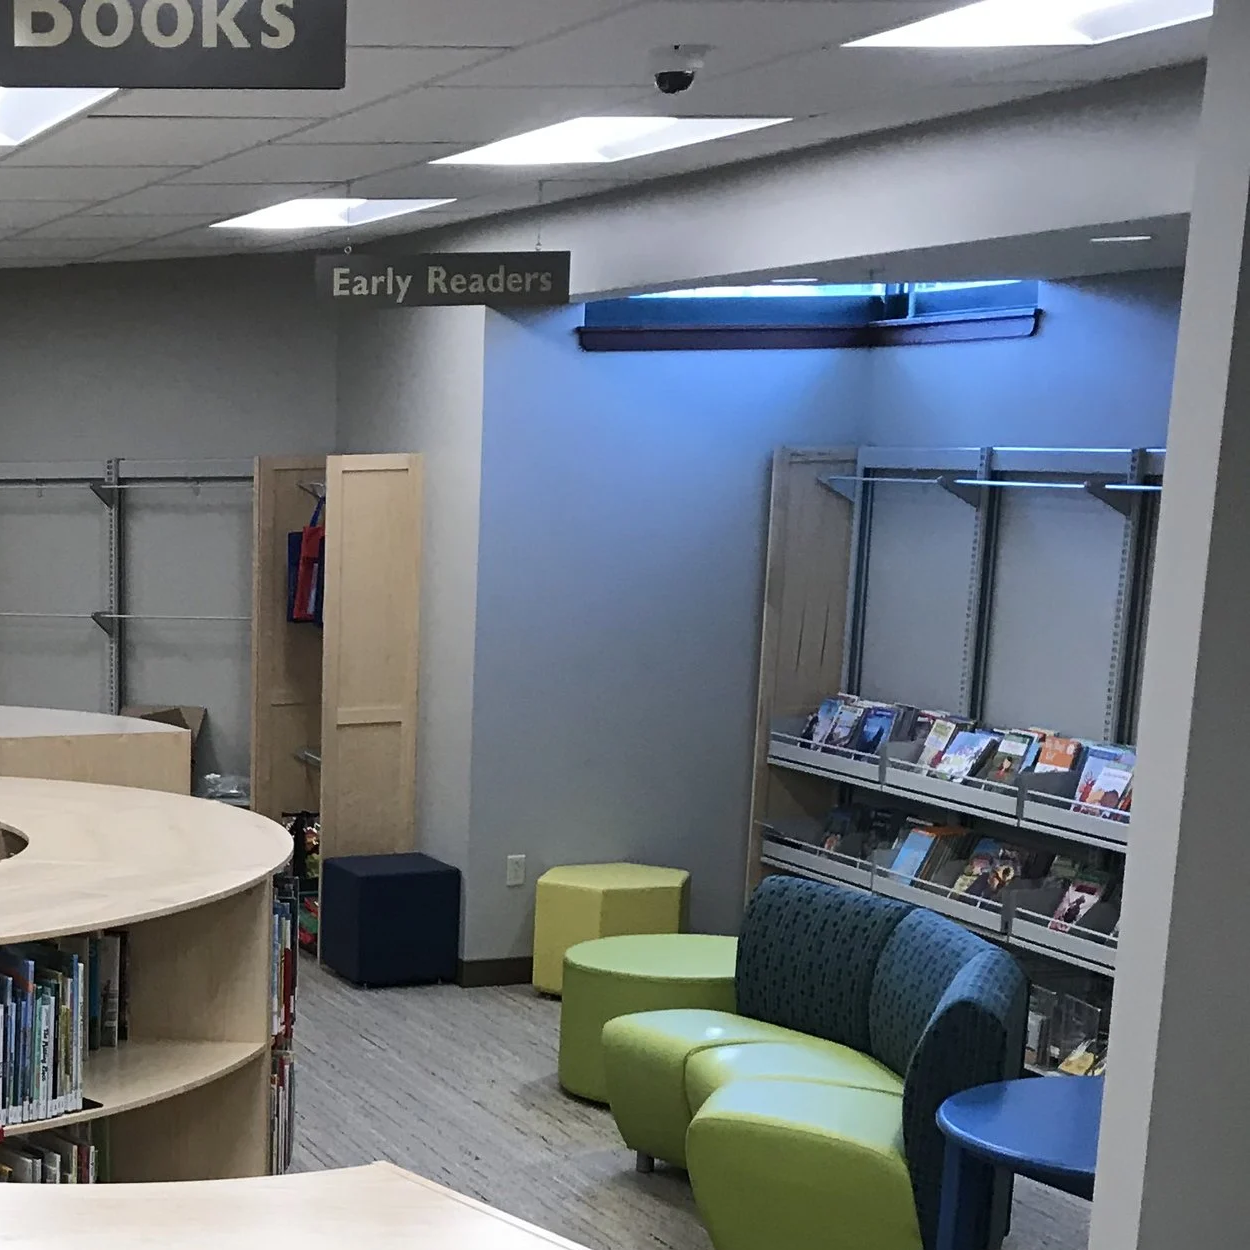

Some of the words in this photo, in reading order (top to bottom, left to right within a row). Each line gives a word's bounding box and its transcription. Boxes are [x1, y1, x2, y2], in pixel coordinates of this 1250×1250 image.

[13, 0, 296, 49] Books
[333, 267, 412, 303] Early
[428, 265, 552, 294] Readers
